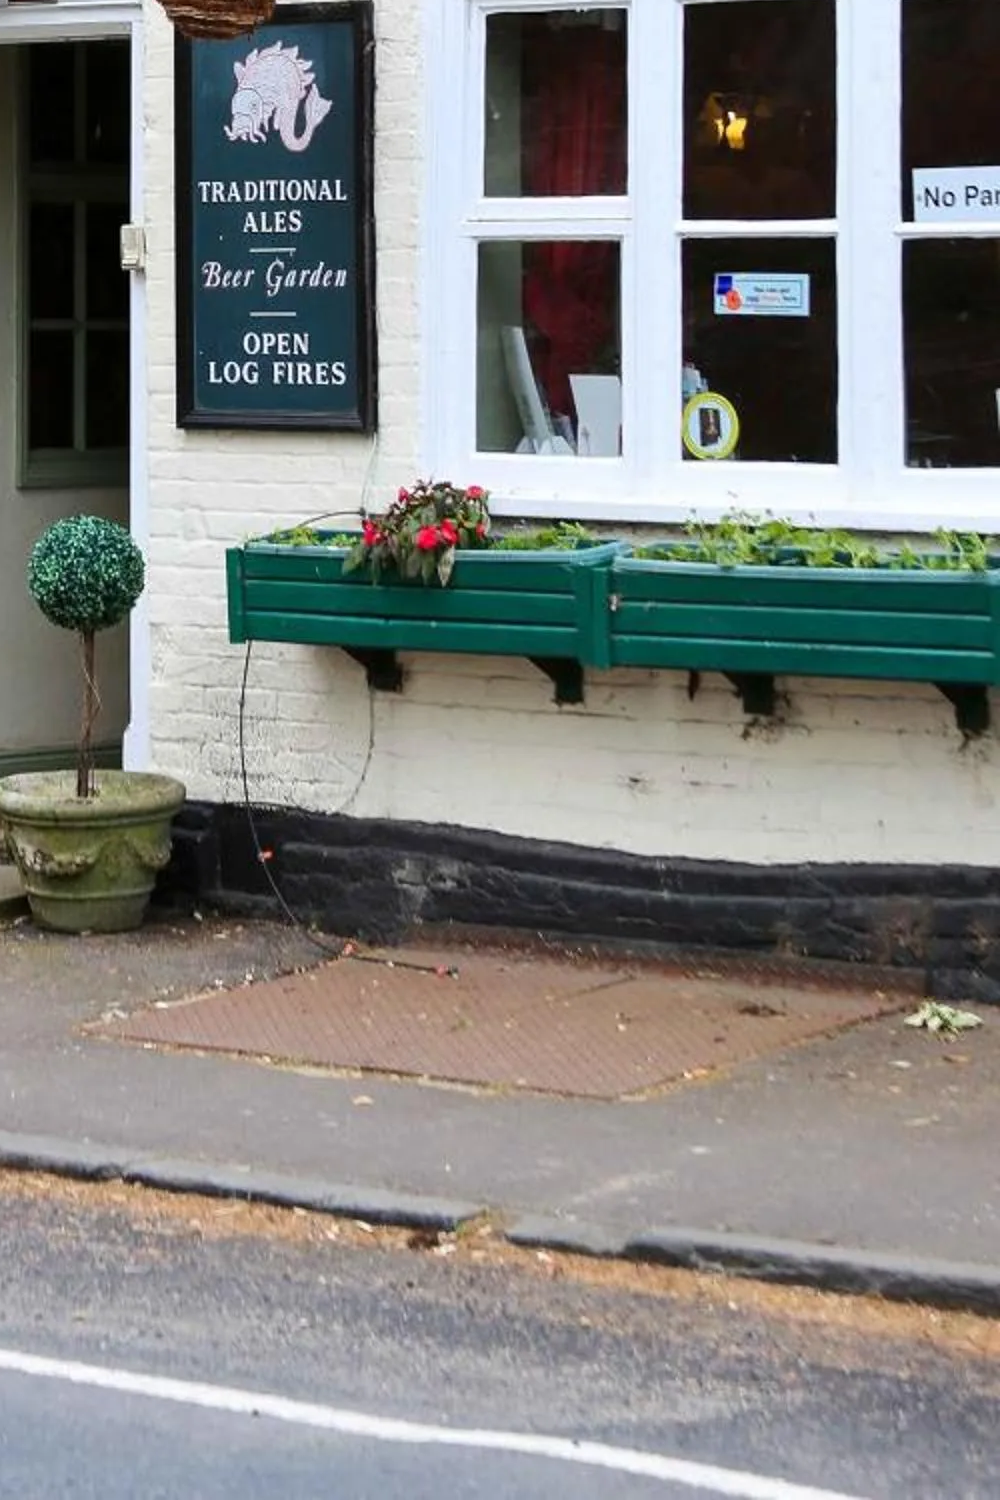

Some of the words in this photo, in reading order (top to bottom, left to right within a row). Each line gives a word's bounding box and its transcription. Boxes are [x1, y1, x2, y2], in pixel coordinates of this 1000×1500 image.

[198, 179, 347, 202] TRADITIONAL
[925, 186, 956, 207] No
[242, 209, 302, 233] ALES
[201, 261, 255, 288] Beer
[266, 257, 347, 297] Garden
[243, 332, 309, 355] OPEN
[208, 361, 259, 384] LOG
[273, 361, 347, 385] FIRES
